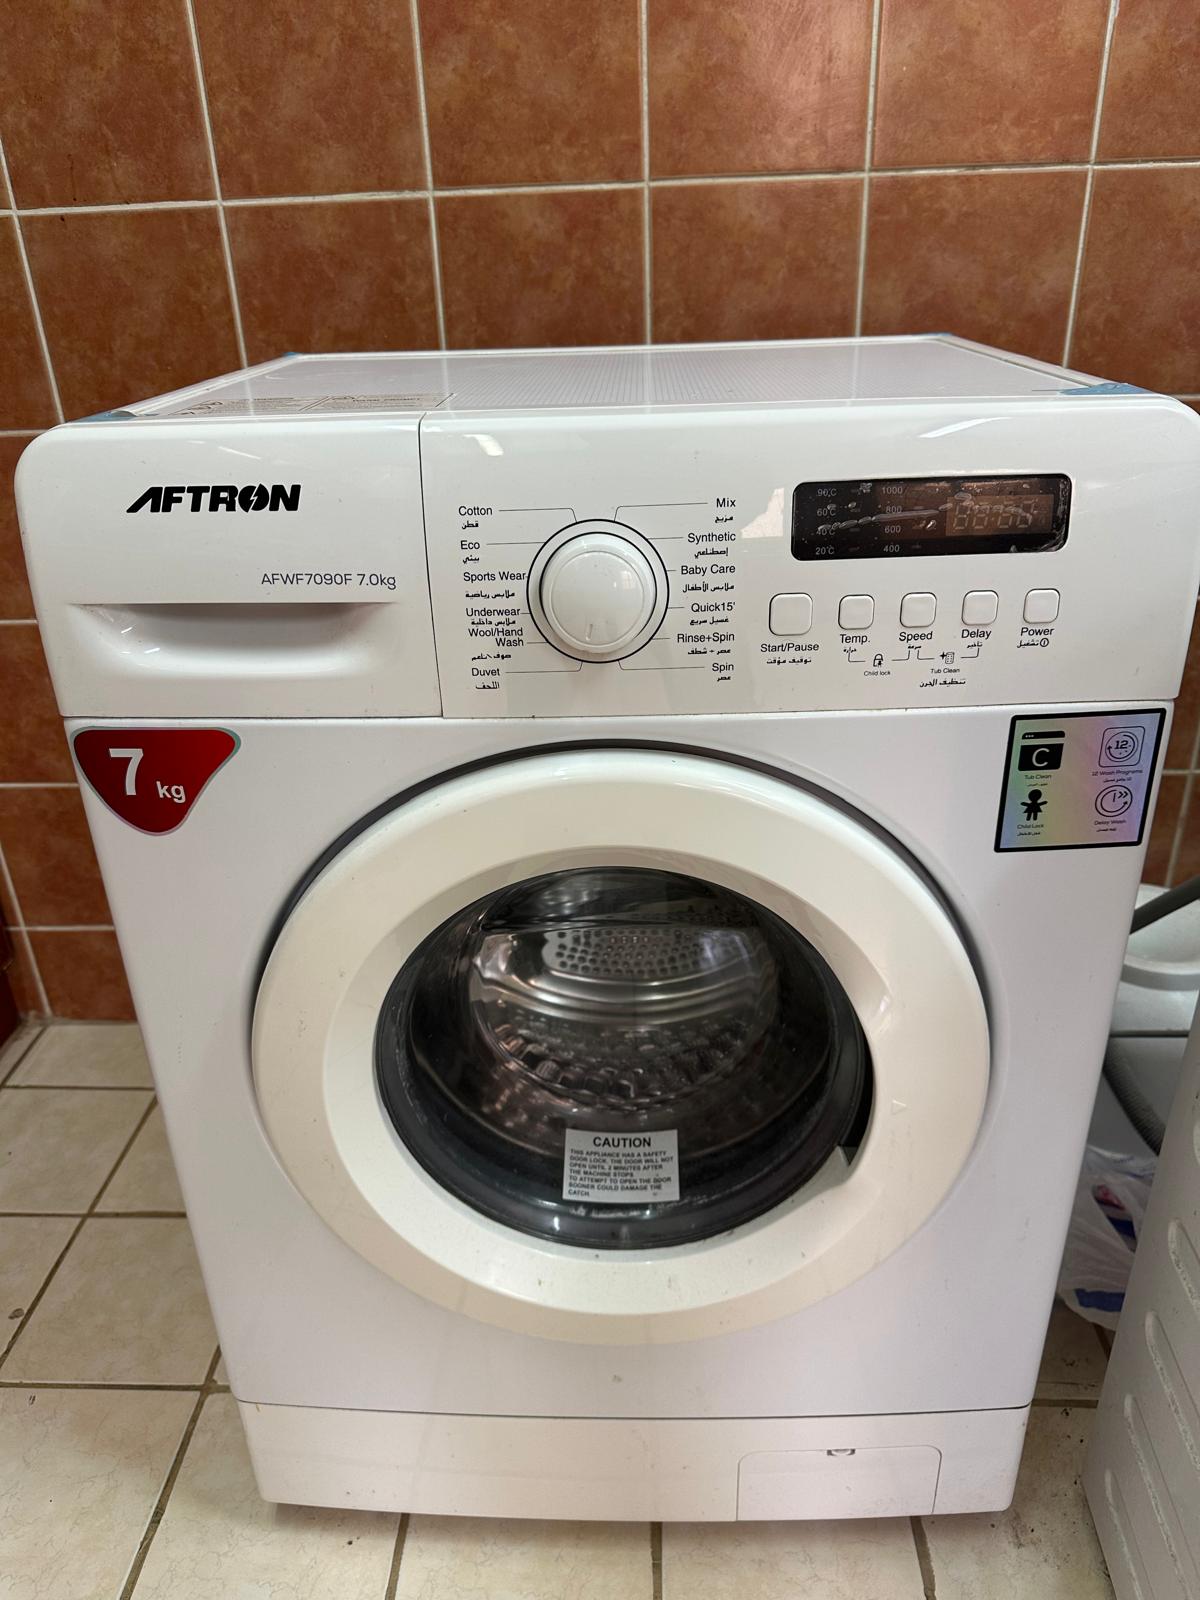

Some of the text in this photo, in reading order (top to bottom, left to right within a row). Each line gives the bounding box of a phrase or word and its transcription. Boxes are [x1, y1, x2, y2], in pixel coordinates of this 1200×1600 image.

[881, 487, 903, 495] 1000
[126, 483, 302, 514] AFTRON
[716, 498, 736, 508] Mix
[458, 505, 493, 516] Cotton
[885, 505, 903, 514] 800
[461, 520, 479, 530] قطن
[884, 525, 901, 534] 600
[687, 531, 737, 545] Synthetic
[460, 540, 480, 550] Eco
[883, 545, 900, 553] 400
[680, 563, 736, 577] Baby Care
[261, 573, 397, 590] AFWF7090F 7.0kg
[463, 570, 526, 584] Sports Wear
[465, 607, 521, 617] Underwear
[690, 601, 736, 613] Quick15'
[468, 627, 524, 638] Wool/Hand
[898, 631, 933, 643] Speed
[961, 628, 992, 640] Delay
[1020, 626, 1055, 637] Power
[495, 637, 524, 647] Wash
[676, 632, 736, 644] Rinse+Spin
[839, 633, 871, 645] Temp.
[760, 642, 820, 653] Start/Pause
[471, 667, 501, 677] Duvet
[711, 662, 735, 674] Spin
[1114, 740, 1129, 750] 12
[1032, 748, 1050, 767] C
[109, 748, 186, 804] 7 kg
[593, 1136, 651, 1148] CAUTION
